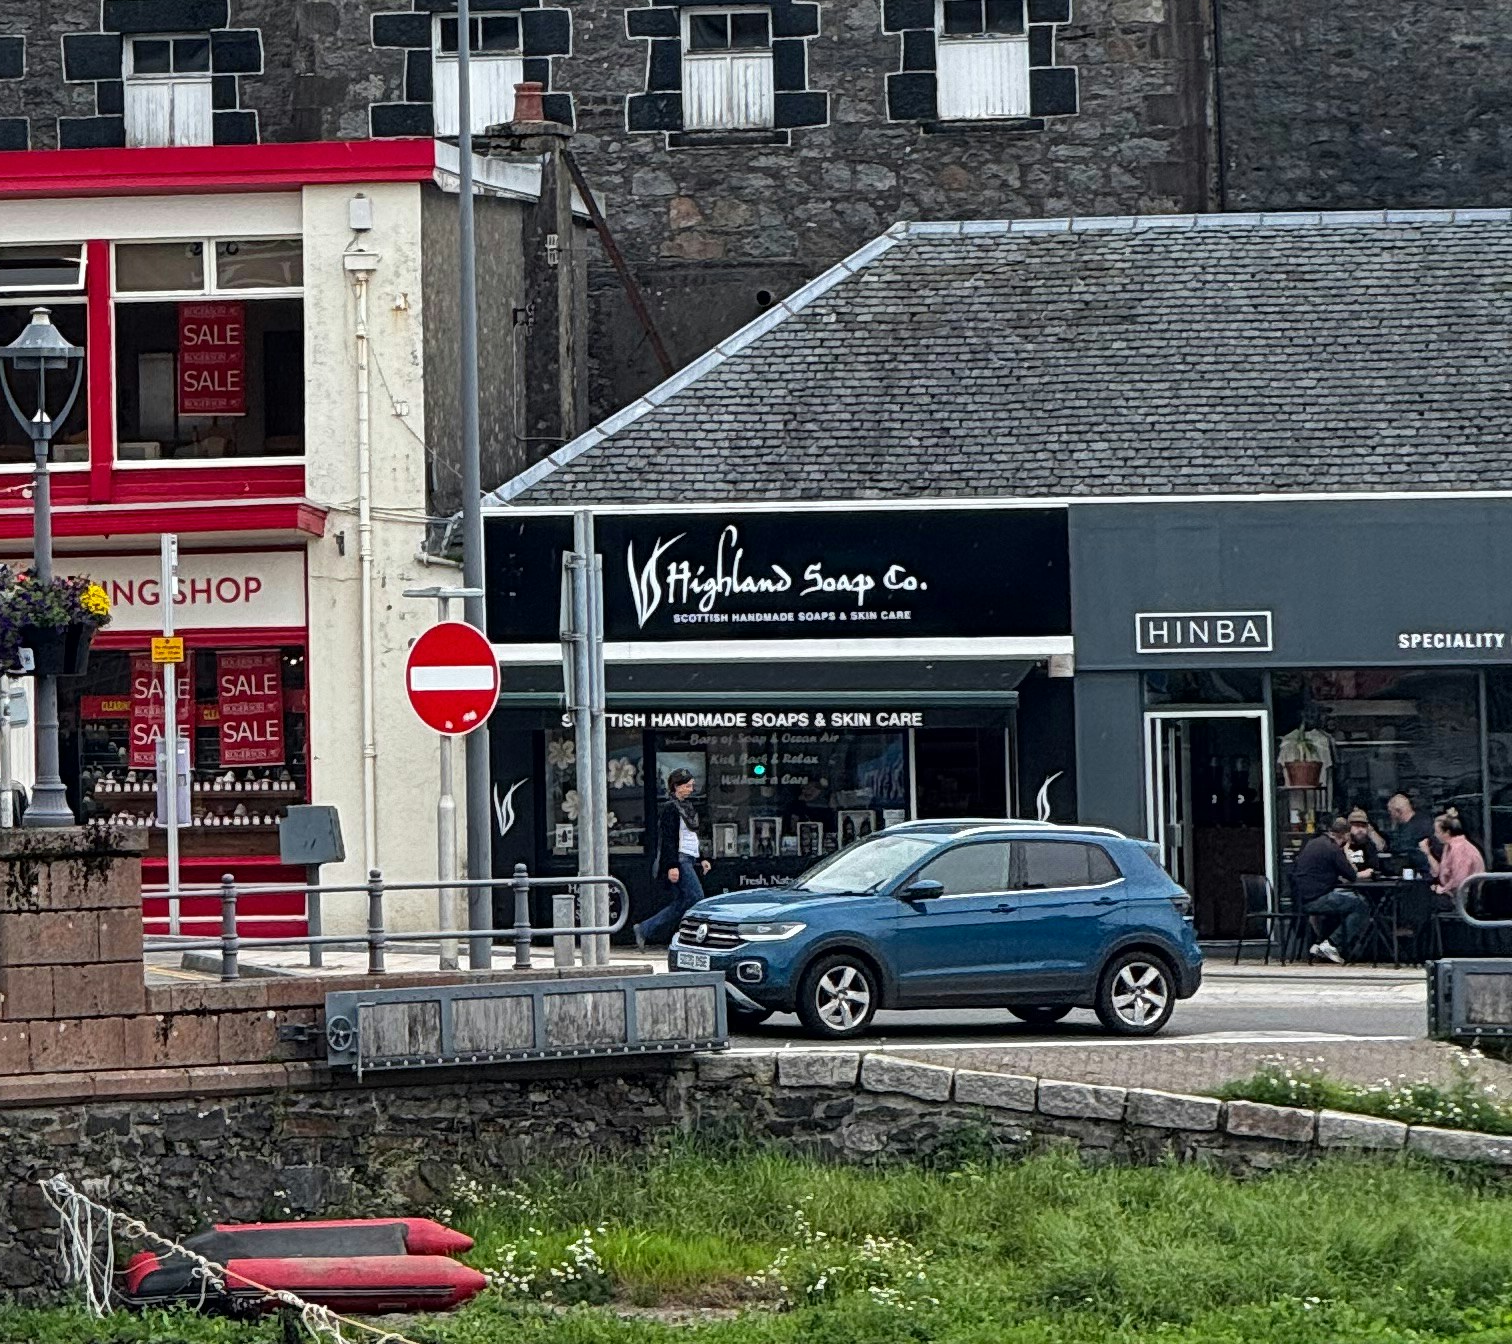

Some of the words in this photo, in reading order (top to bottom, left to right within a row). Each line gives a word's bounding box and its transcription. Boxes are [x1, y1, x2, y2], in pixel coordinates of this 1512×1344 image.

[183, 324, 240, 346] SALE
[183, 370, 241, 392] SALE
[666, 524, 792, 612] Highland
[799, 562, 875, 606] Soap
[882, 564, 928, 591] Co.
[172, 576, 262, 605] SHOP
[673, 613, 729, 623] SCOTTISH
[731, 612, 794, 623] HANDMADE
[798, 611, 836, 622] SOAPS
[839, 612, 847, 621] &
[850, 611, 877, 621] SKIN
[881, 610, 912, 620] CARE
[1148, 619, 1261, 645] HINBA
[1397, 632, 1505, 650] SPECIALITY
[134, 678, 191, 699] SAE
[221, 673, 277, 697] SALE
[561, 713, 647, 728] STISH
[651, 712, 748, 727] HANDMADE
[751, 712, 809, 727] SOAPS
[814, 712, 826, 727] &
[830, 712, 871, 727] SKIN
[876, 711, 923, 726] CARE
[133, 724, 191, 745] SAE
[223, 719, 280, 743] SALE
